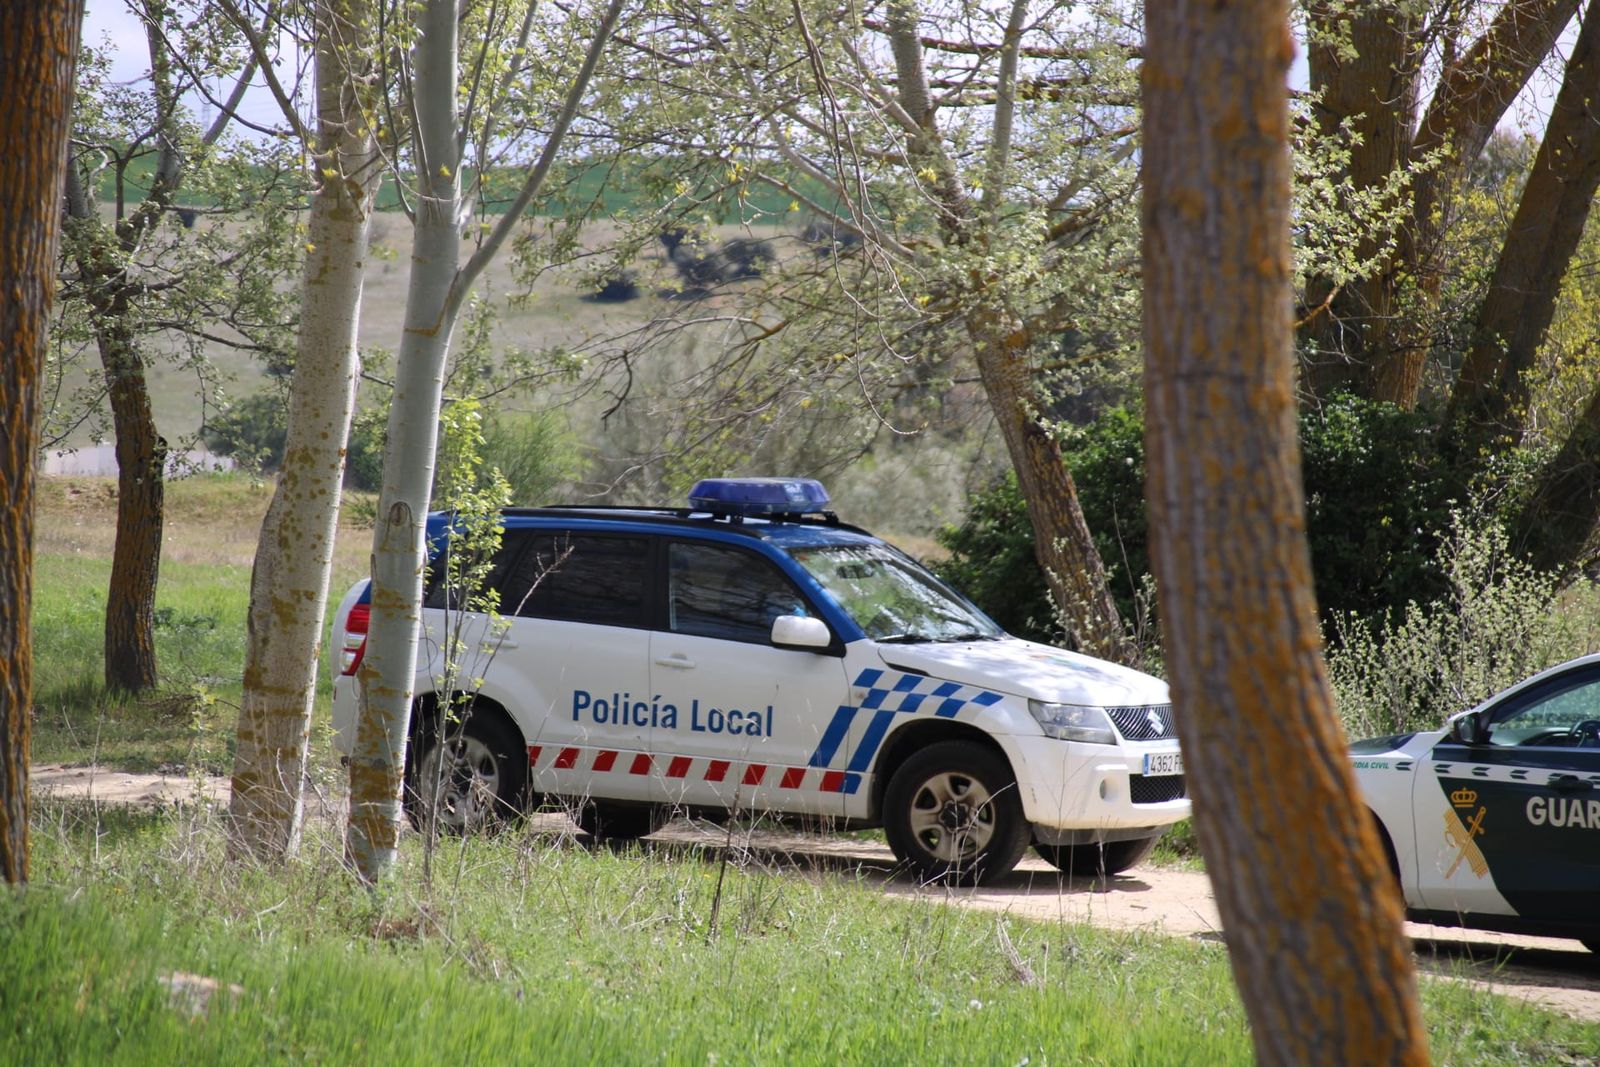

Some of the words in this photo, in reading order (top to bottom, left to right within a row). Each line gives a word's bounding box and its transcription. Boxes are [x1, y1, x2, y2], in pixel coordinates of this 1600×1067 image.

[572, 690, 678, 729] Policía
[691, 699, 774, 738] Local
[1150, 756, 1173, 773] 4362
[1370, 761, 1389, 769] CIVIL
[1526, 796, 1600, 829] GUAR
